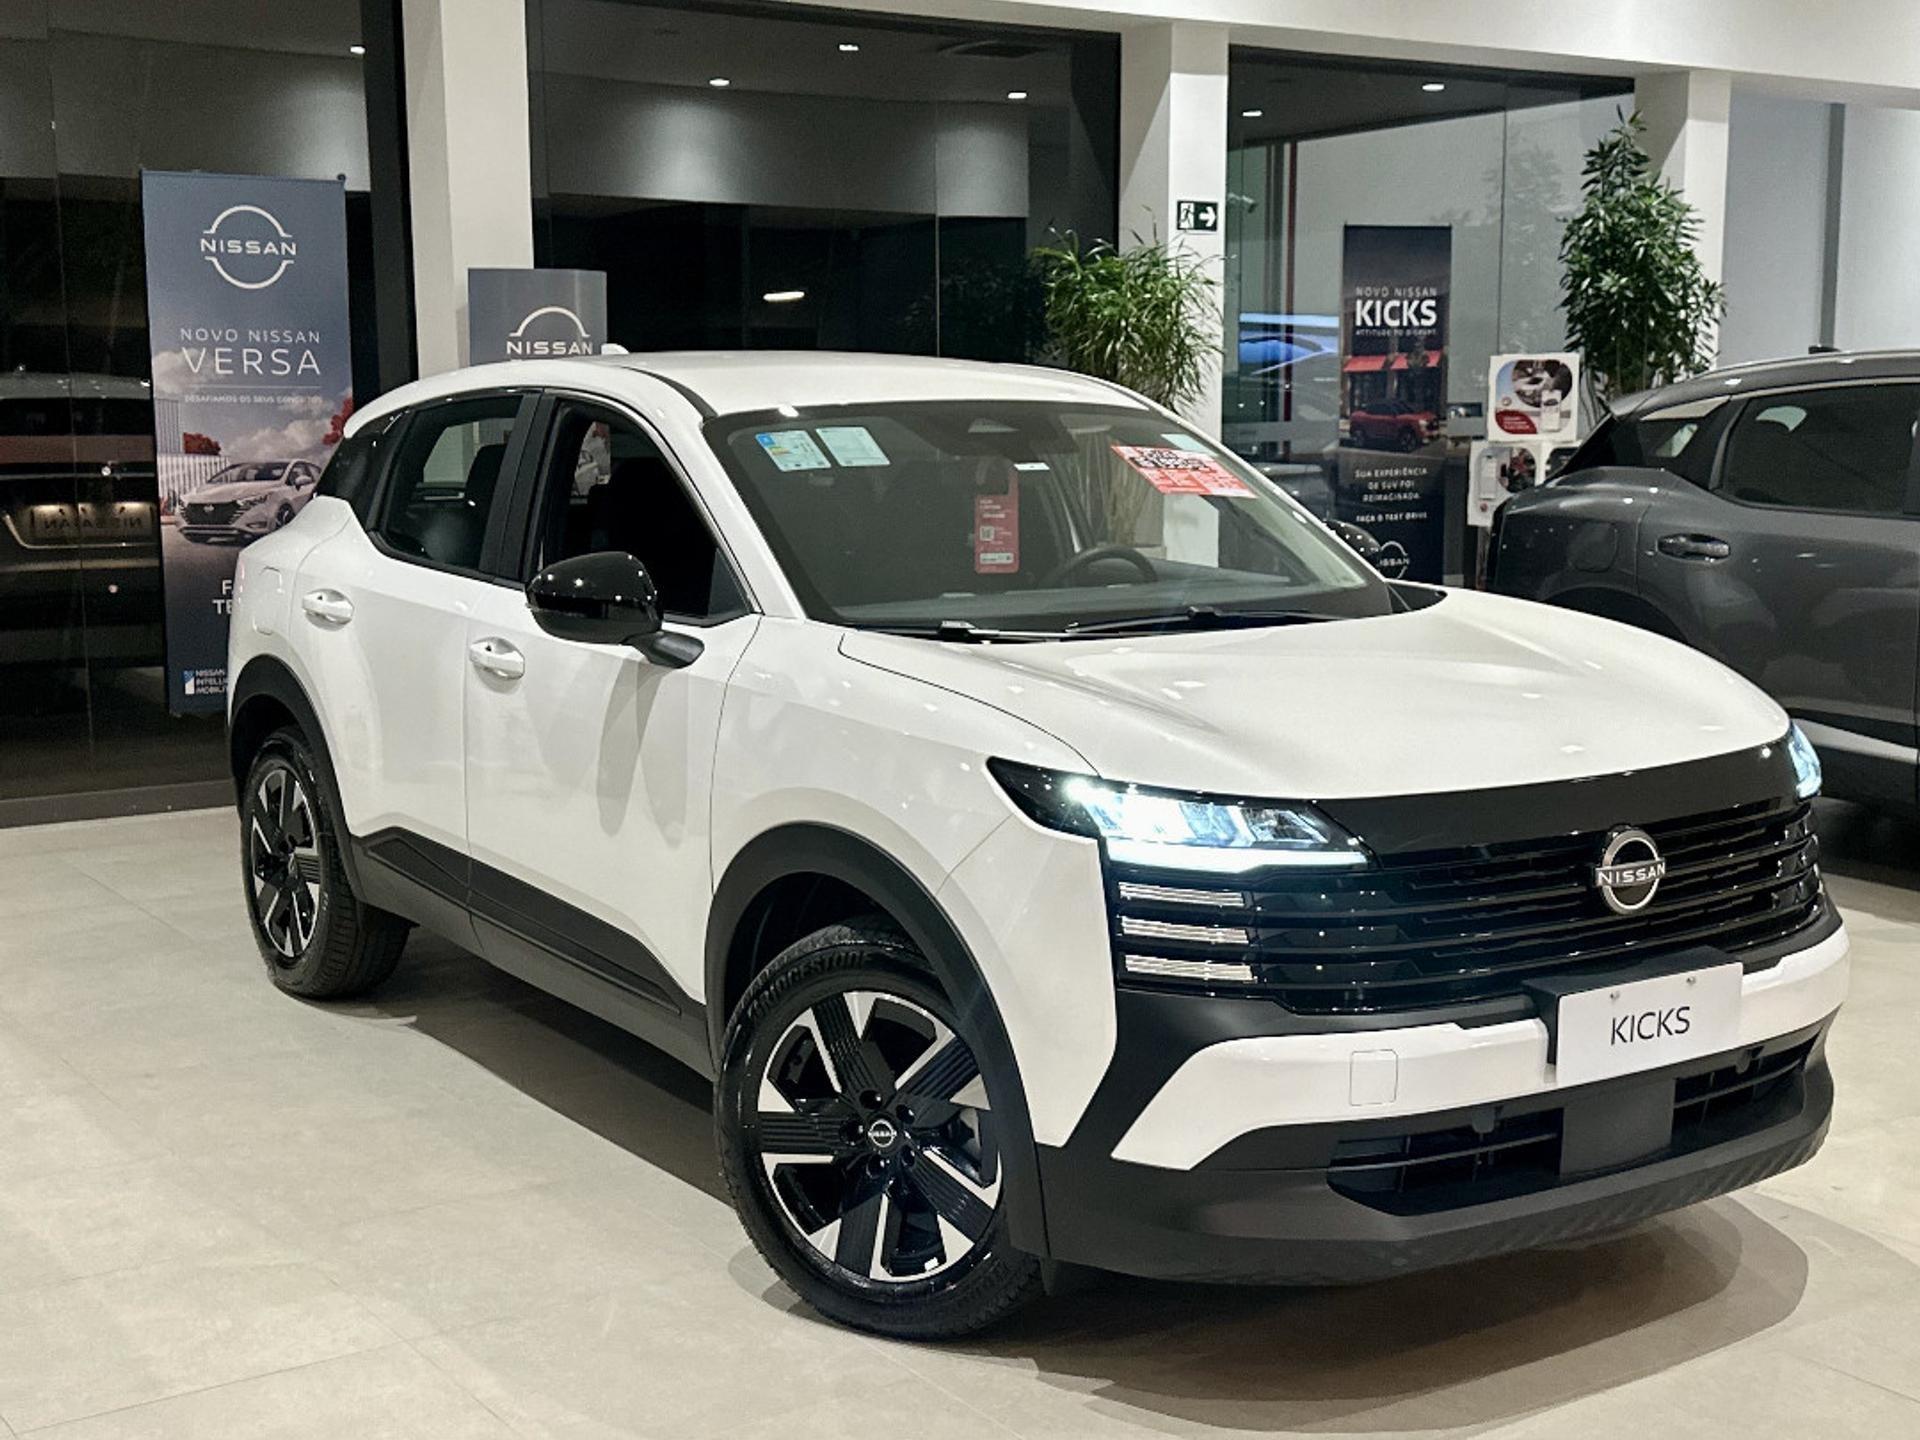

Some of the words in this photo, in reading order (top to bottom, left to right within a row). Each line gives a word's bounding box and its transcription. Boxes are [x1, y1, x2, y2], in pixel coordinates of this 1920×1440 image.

[200, 238, 296, 255] NISSAN
[1355, 286, 1390, 297] NOVO
[1394, 287, 1437, 298] NISSAN
[1355, 299, 1438, 327] KICKS
[180, 328, 239, 342] NOVO
[248, 330, 320, 344] NISSAN
[506, 341, 593, 355] NISSAN
[181, 346, 321, 376] VERSA
[1599, 862, 1666, 884] NISSAN
[1610, 1006, 1691, 1046] KICKS
